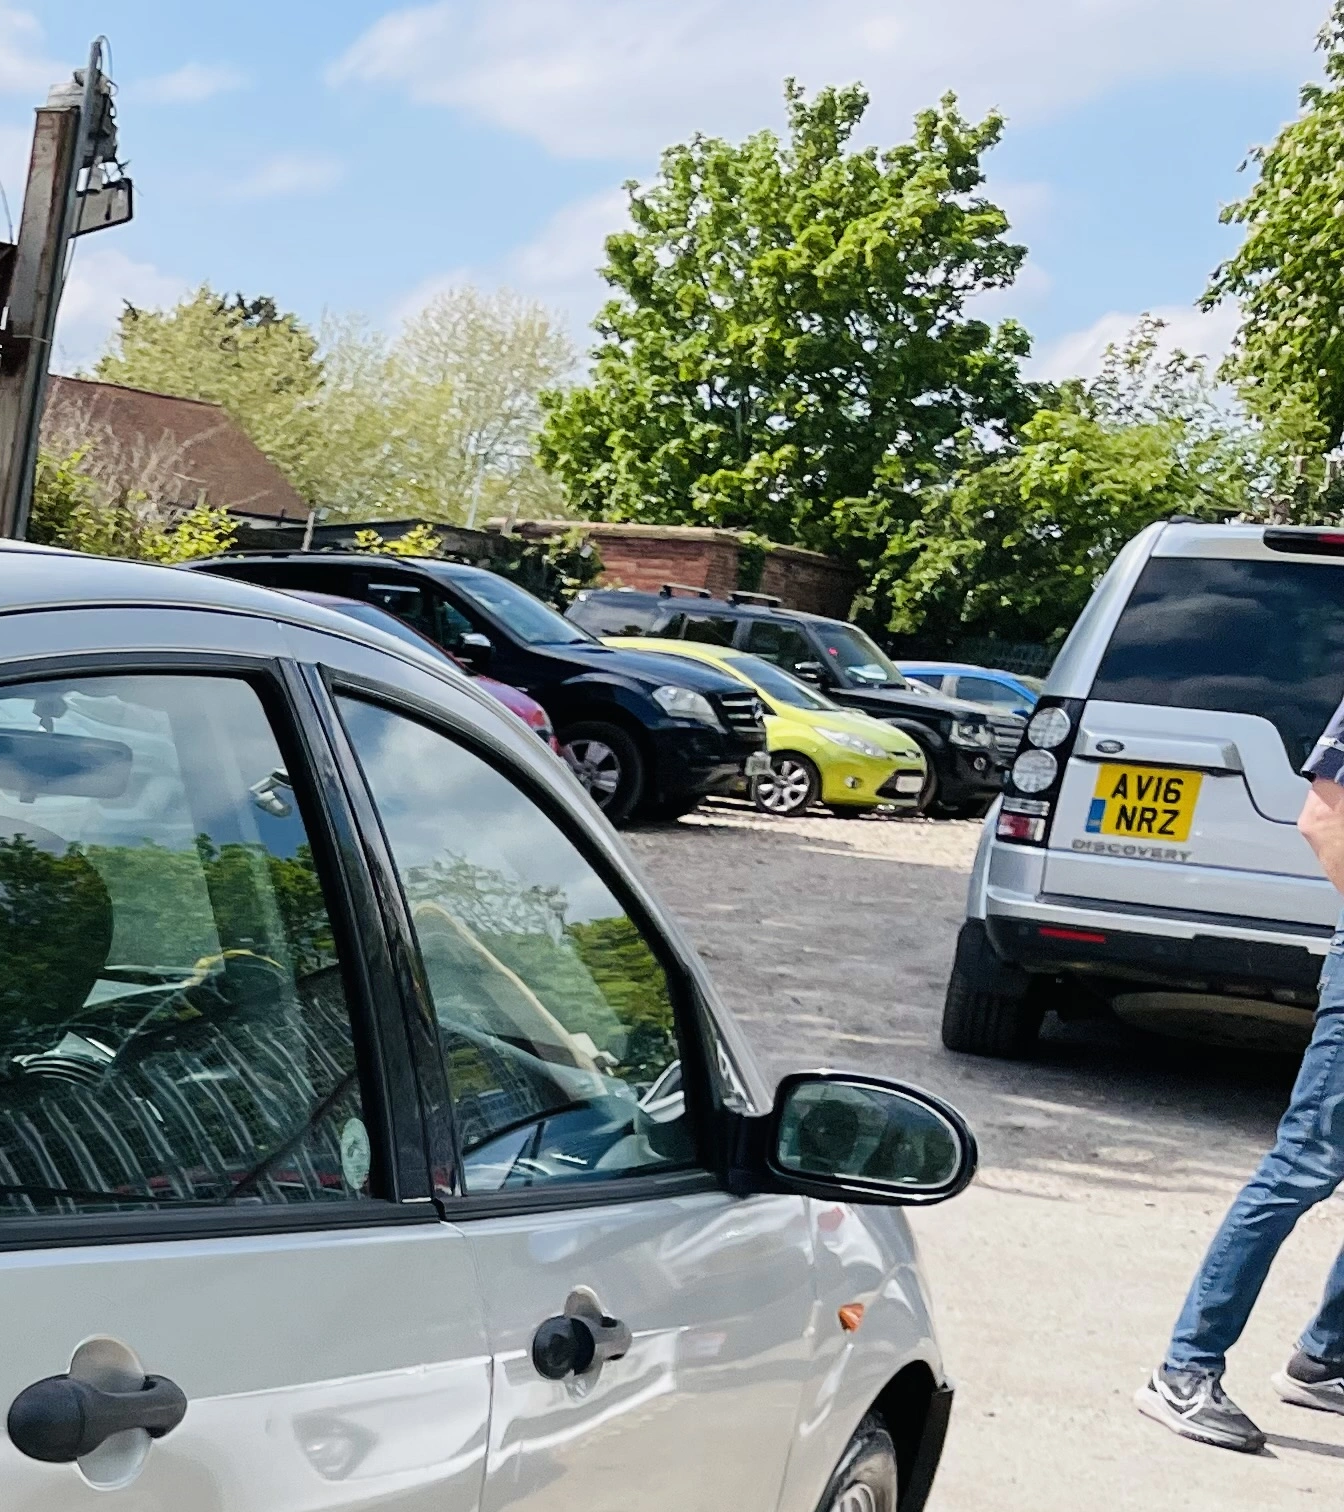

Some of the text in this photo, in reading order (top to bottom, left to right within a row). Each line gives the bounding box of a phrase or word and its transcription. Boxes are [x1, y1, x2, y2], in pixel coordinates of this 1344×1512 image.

[1110, 773, 1184, 804] AV16
[1115, 804, 1180, 836] NRZ
[1071, 838, 1193, 862] DISCOVERY
